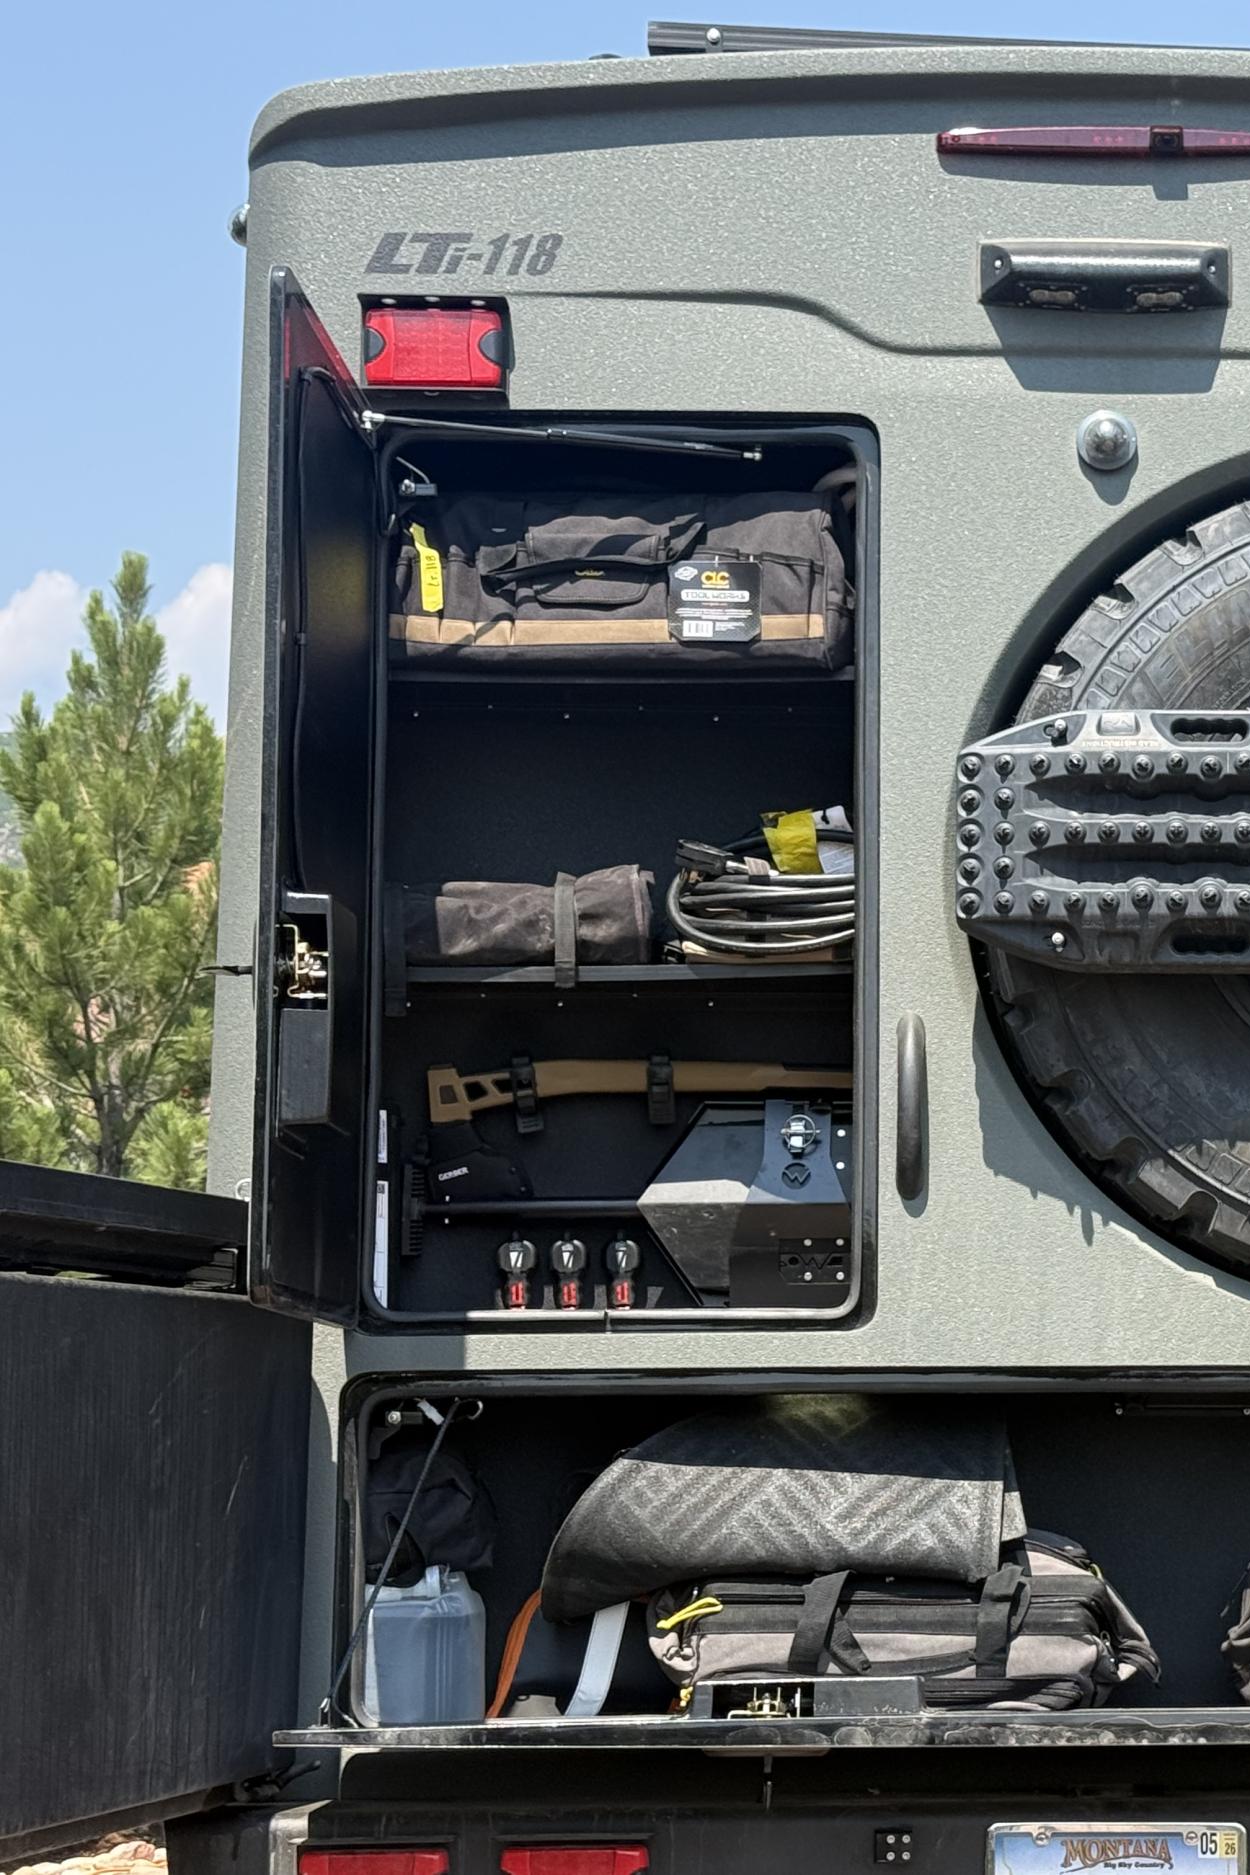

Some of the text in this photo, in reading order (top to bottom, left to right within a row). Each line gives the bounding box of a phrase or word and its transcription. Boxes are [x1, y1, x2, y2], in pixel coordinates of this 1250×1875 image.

[438, 1166, 469, 1181] GERBER
[1060, 1838, 1173, 1868] MONTANA
[1200, 1832, 1218, 1855] 05
[1224, 1842, 1236, 1856] 26
